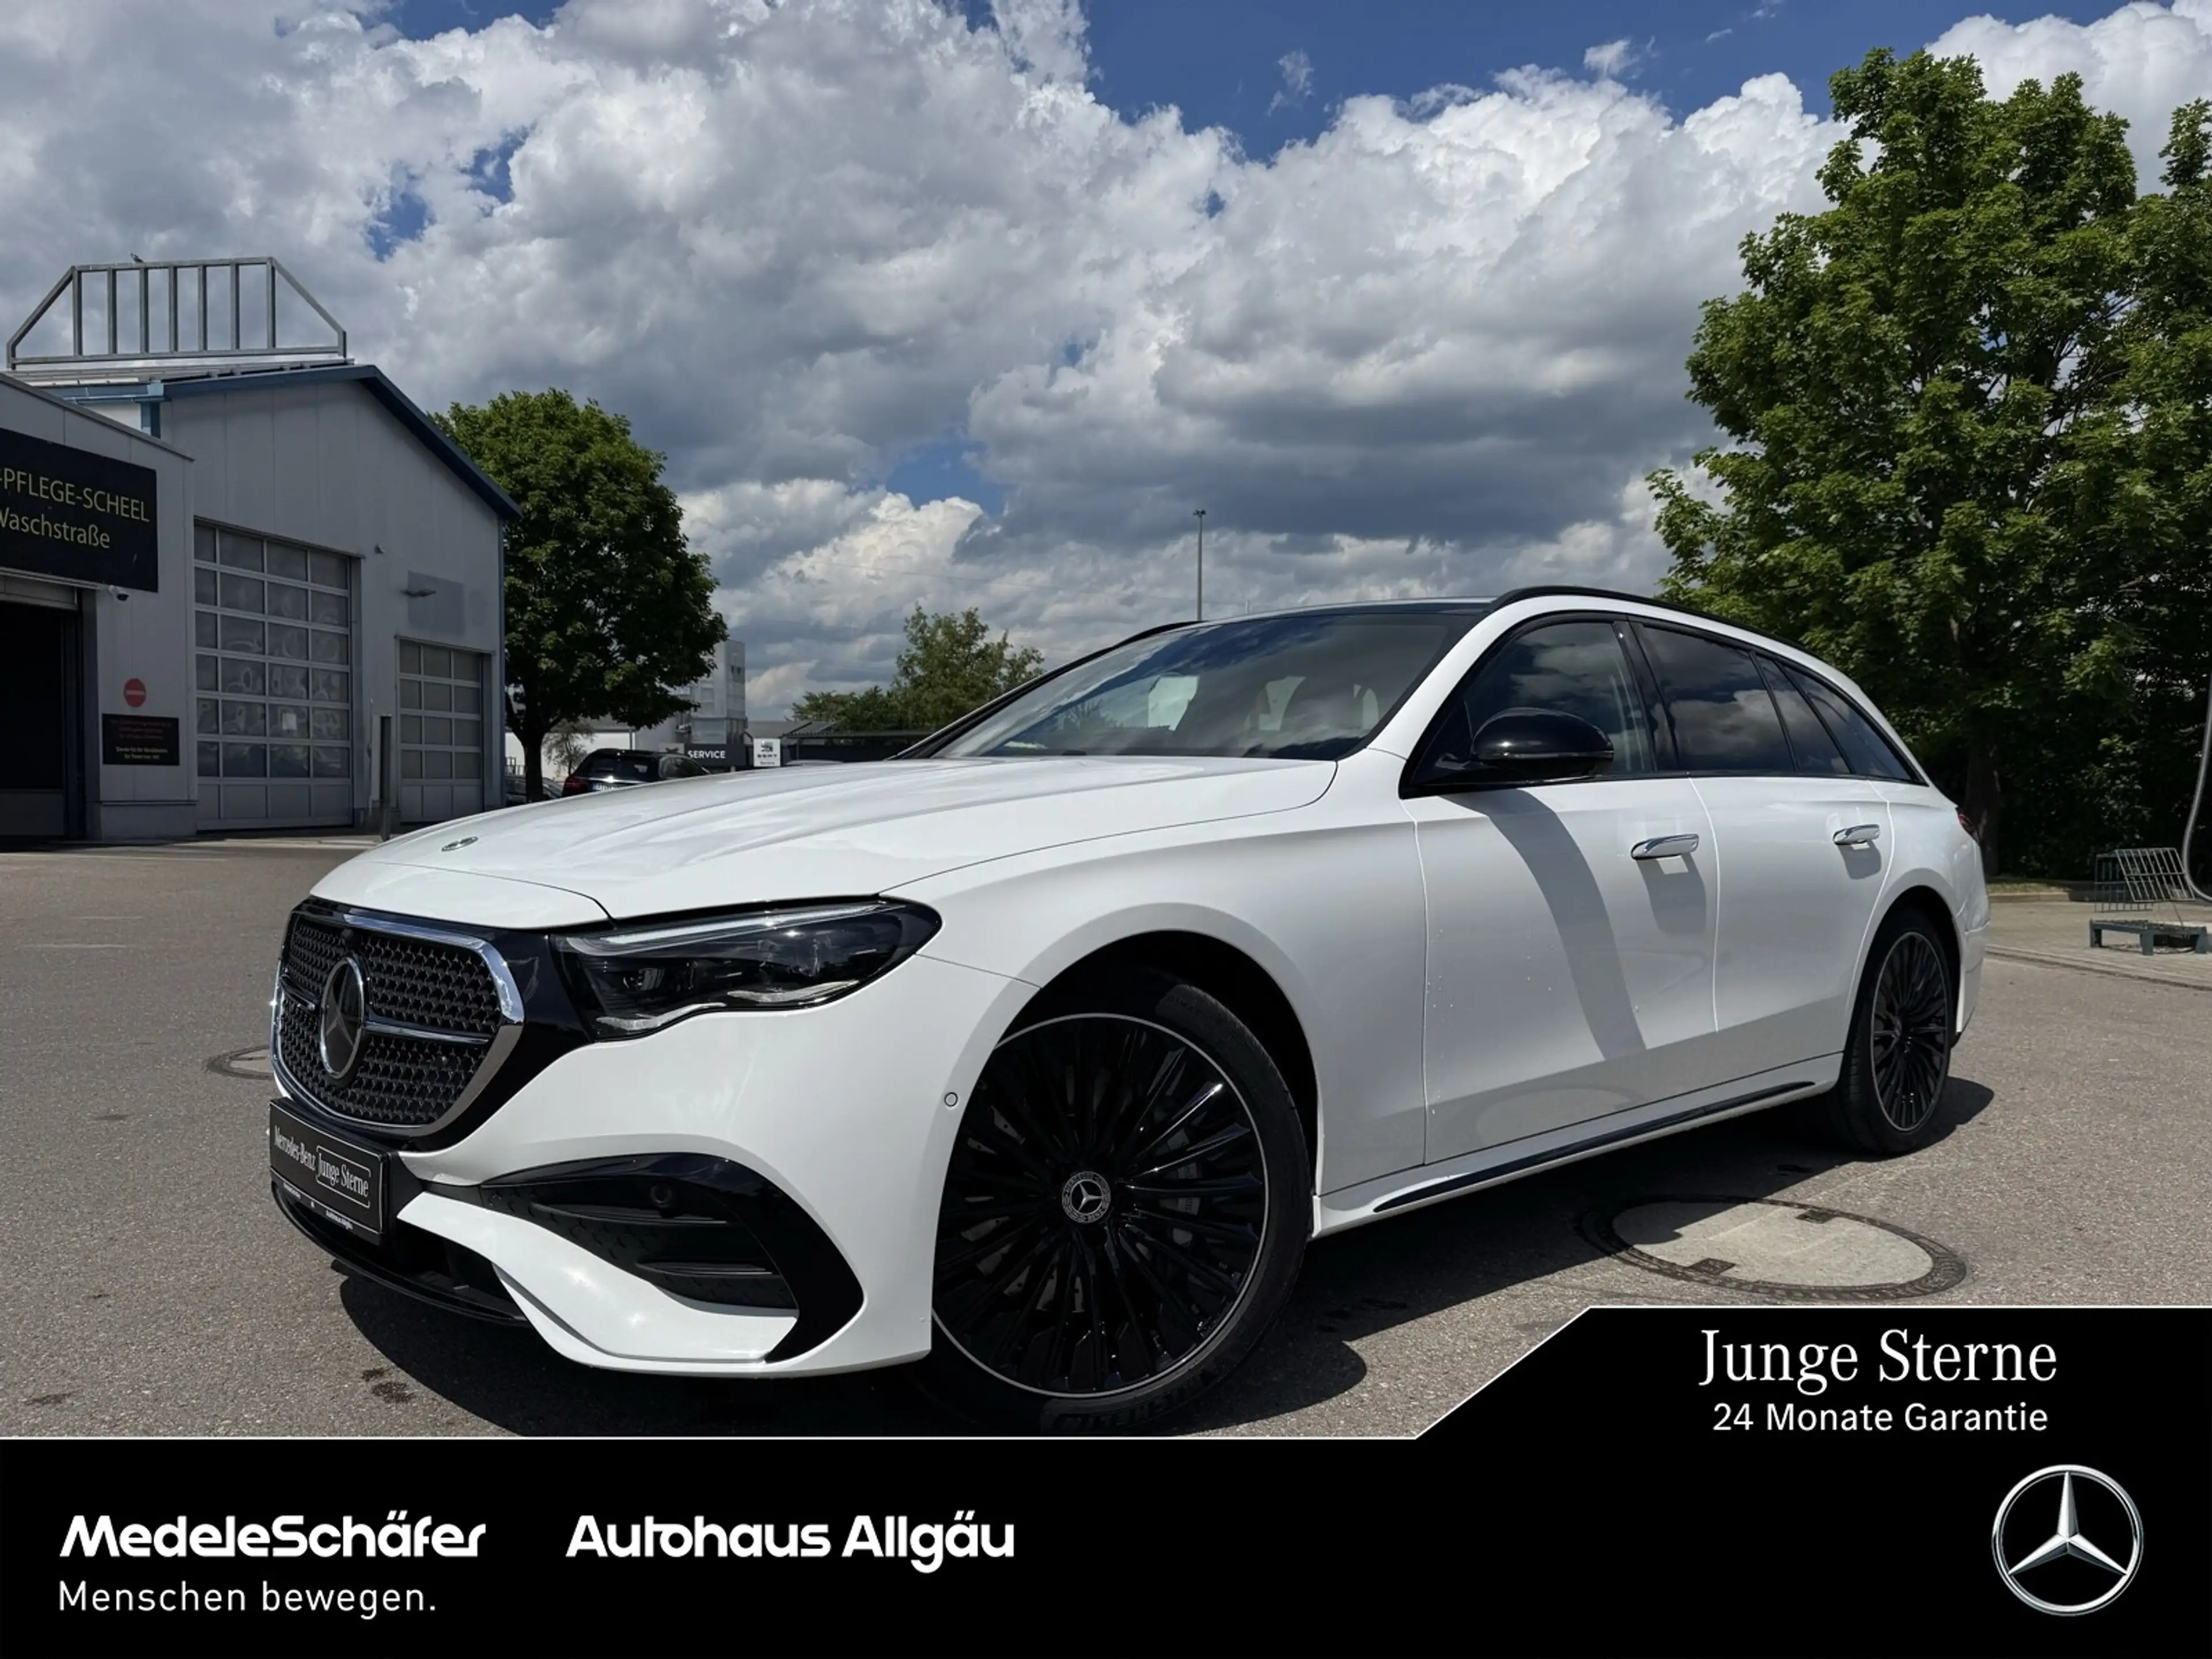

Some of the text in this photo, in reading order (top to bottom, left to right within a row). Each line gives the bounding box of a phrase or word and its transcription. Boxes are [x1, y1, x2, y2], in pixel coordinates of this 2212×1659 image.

[687, 750, 726, 759] SERVICE
[274, 1125, 316, 1171] Mercedes-Benz
[317, 1153, 340, 1187] Junge
[341, 1164, 369, 1198] Sterne
